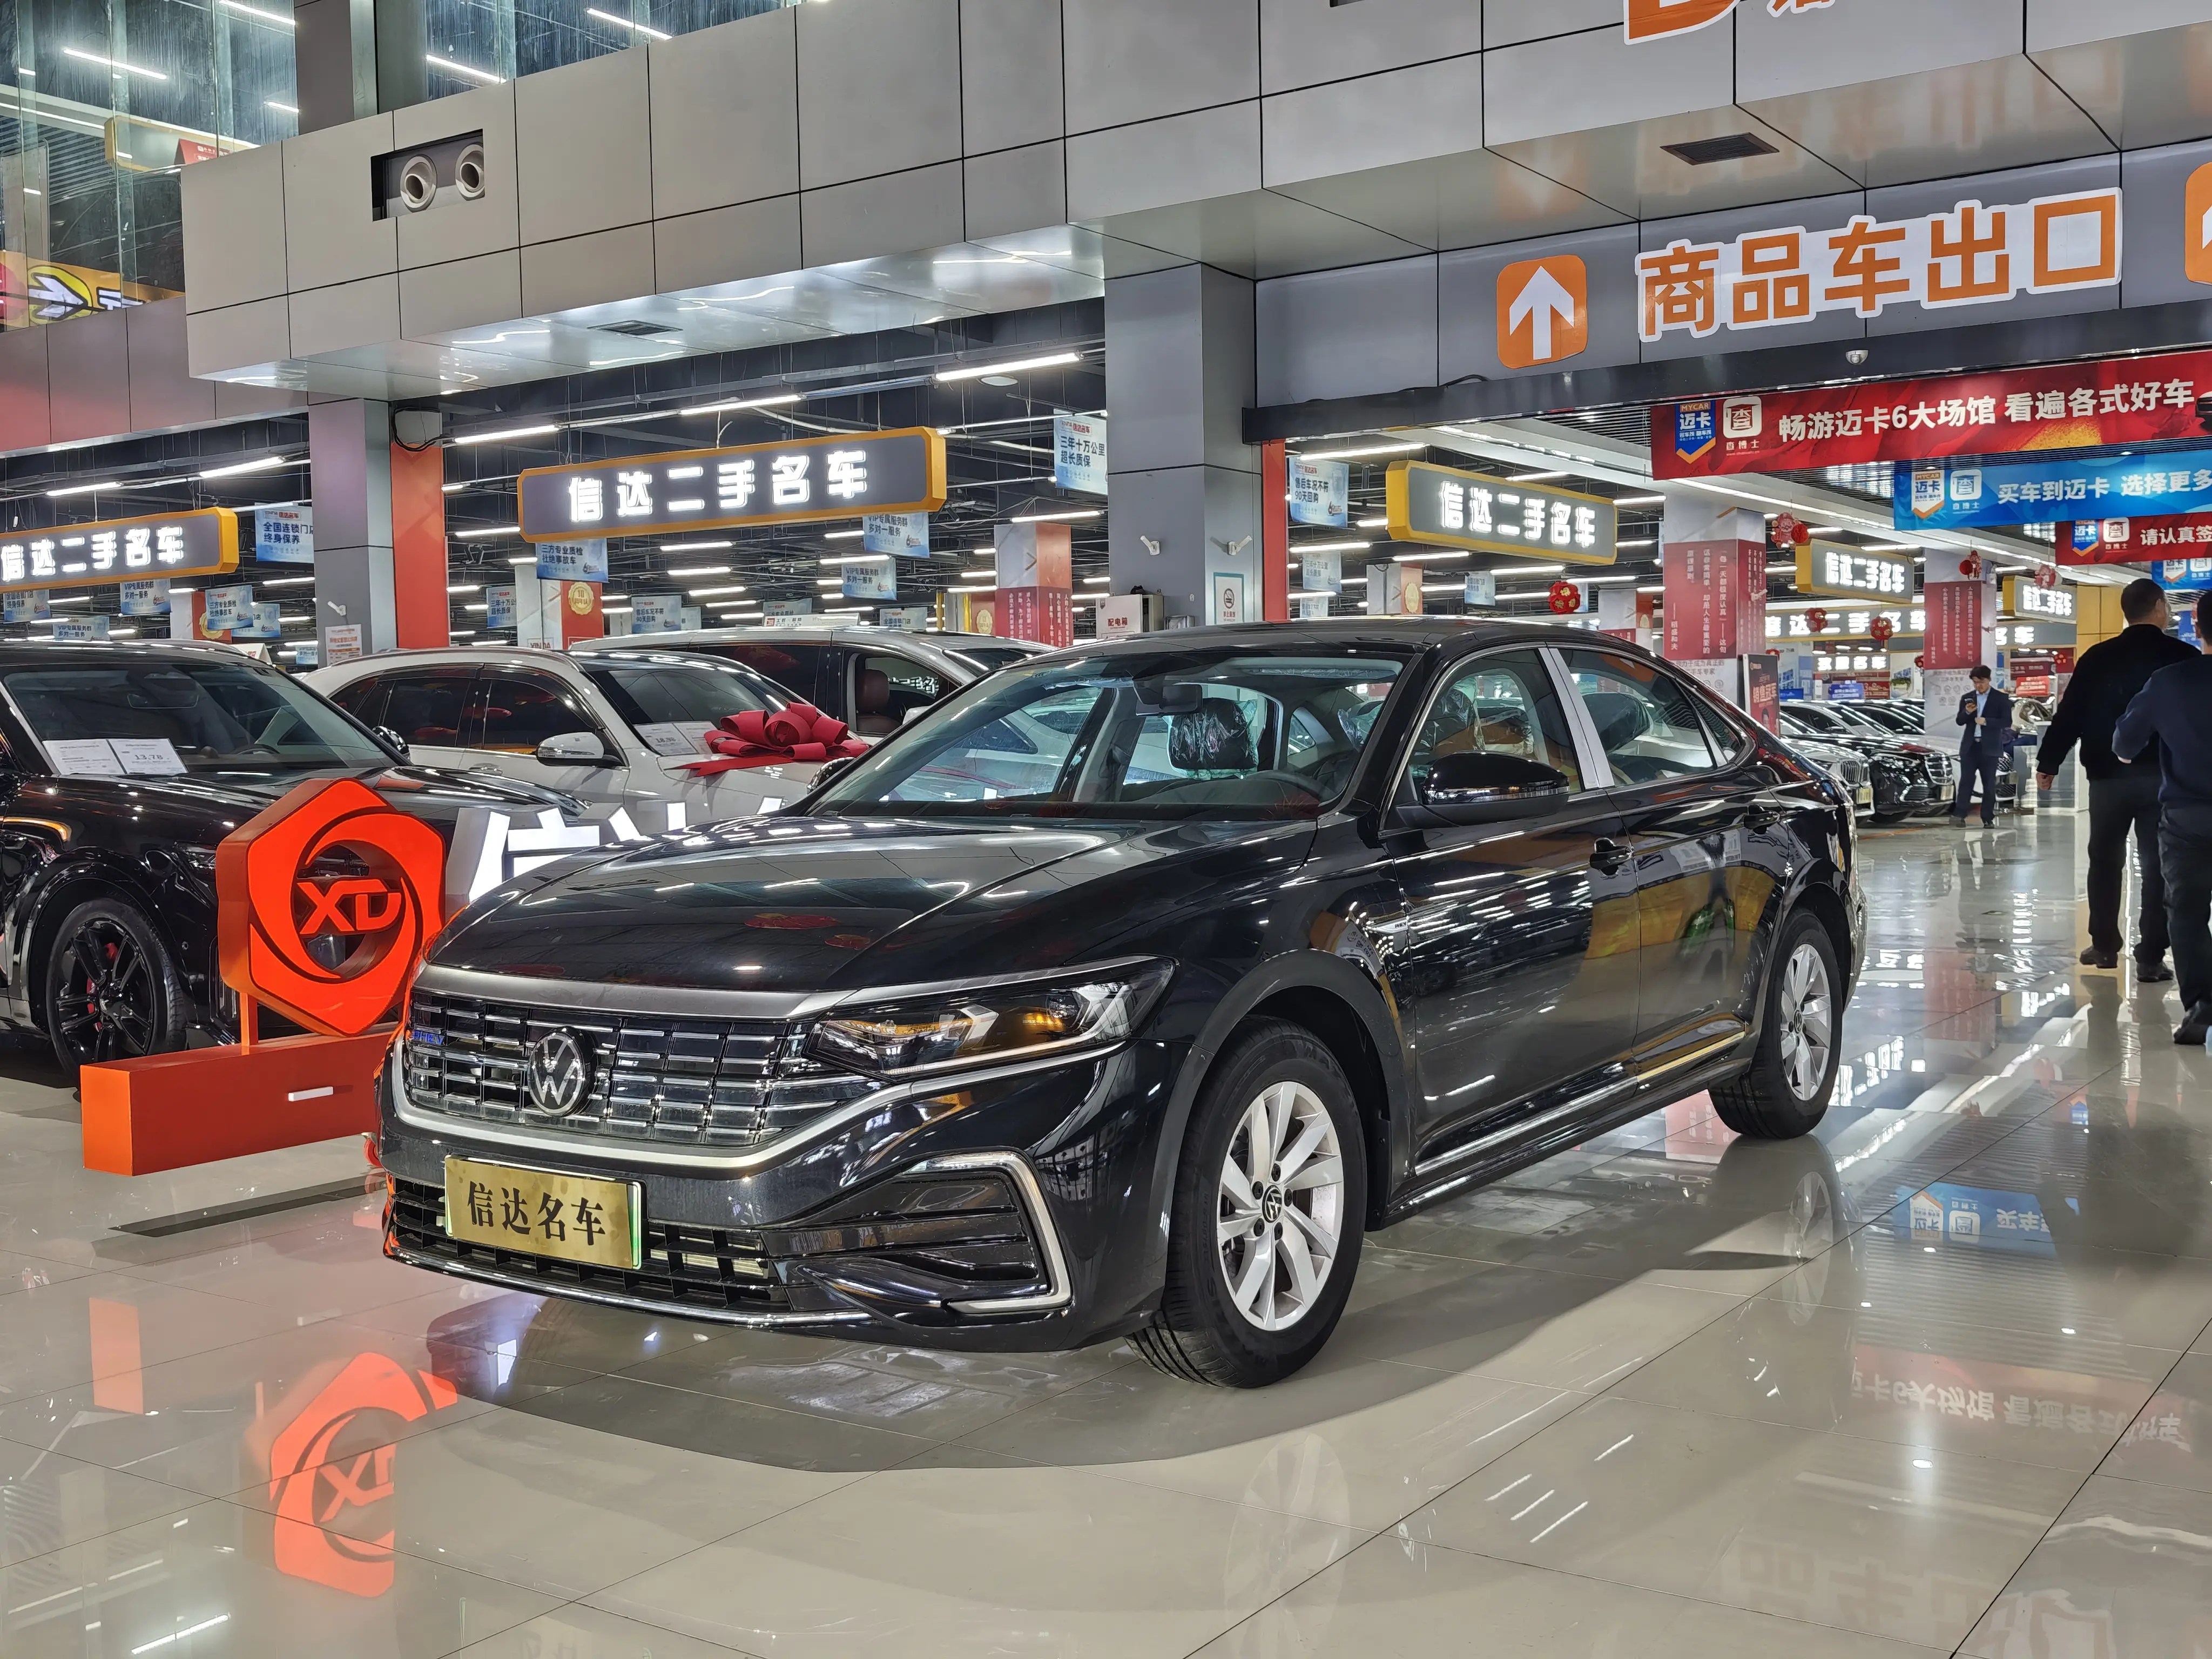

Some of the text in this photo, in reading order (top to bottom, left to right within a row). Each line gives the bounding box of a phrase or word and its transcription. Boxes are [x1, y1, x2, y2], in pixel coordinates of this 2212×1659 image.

[1638, 191, 2118, 339] 商品车出口
[1681, 403, 1709, 412] MYCAR
[1778, 377, 2196, 443] 畅游迈卡6大场馆 看遍各式好车
[1680, 412, 1711, 430] 迈卡
[1060, 435, 1105, 456] 三年十万公里
[1726, 439, 1760, 450] 查博士
[1061, 450, 1091, 468] 超长质保
[568, 449, 867, 523] 信达二手名车
[1295, 477, 1328, 493] 售后车况不符
[1915, 480, 1940, 493] 迈卡
[1997, 469, 2212, 505] 买车到迈卡 选择更多
[1295, 490, 1318, 503] 90天回购
[1440, 481, 1596, 547] 信达二手名车
[868, 523, 901, 537] 多对一服务
[2074, 525, 2096, 536] 迈卡
[2140, 524, 2212, 546] 请认真签
[264, 532, 300, 544] 终身保养
[1, 525, 185, 582] 信达二手名车
[541, 544, 583, 556] 三方专业质检
[542, 554, 576, 564] 杜绝事故车
[1825, 551, 1905, 593] 信达二手名车
[847, 576, 873, 584] 多对一服务
[125, 590, 149, 600] 多对一服务
[490, 598, 516, 607] 三年十万公
[1108, 617, 1128, 626] 配电箱
[467, 1180, 606, 1246] 信达名车
